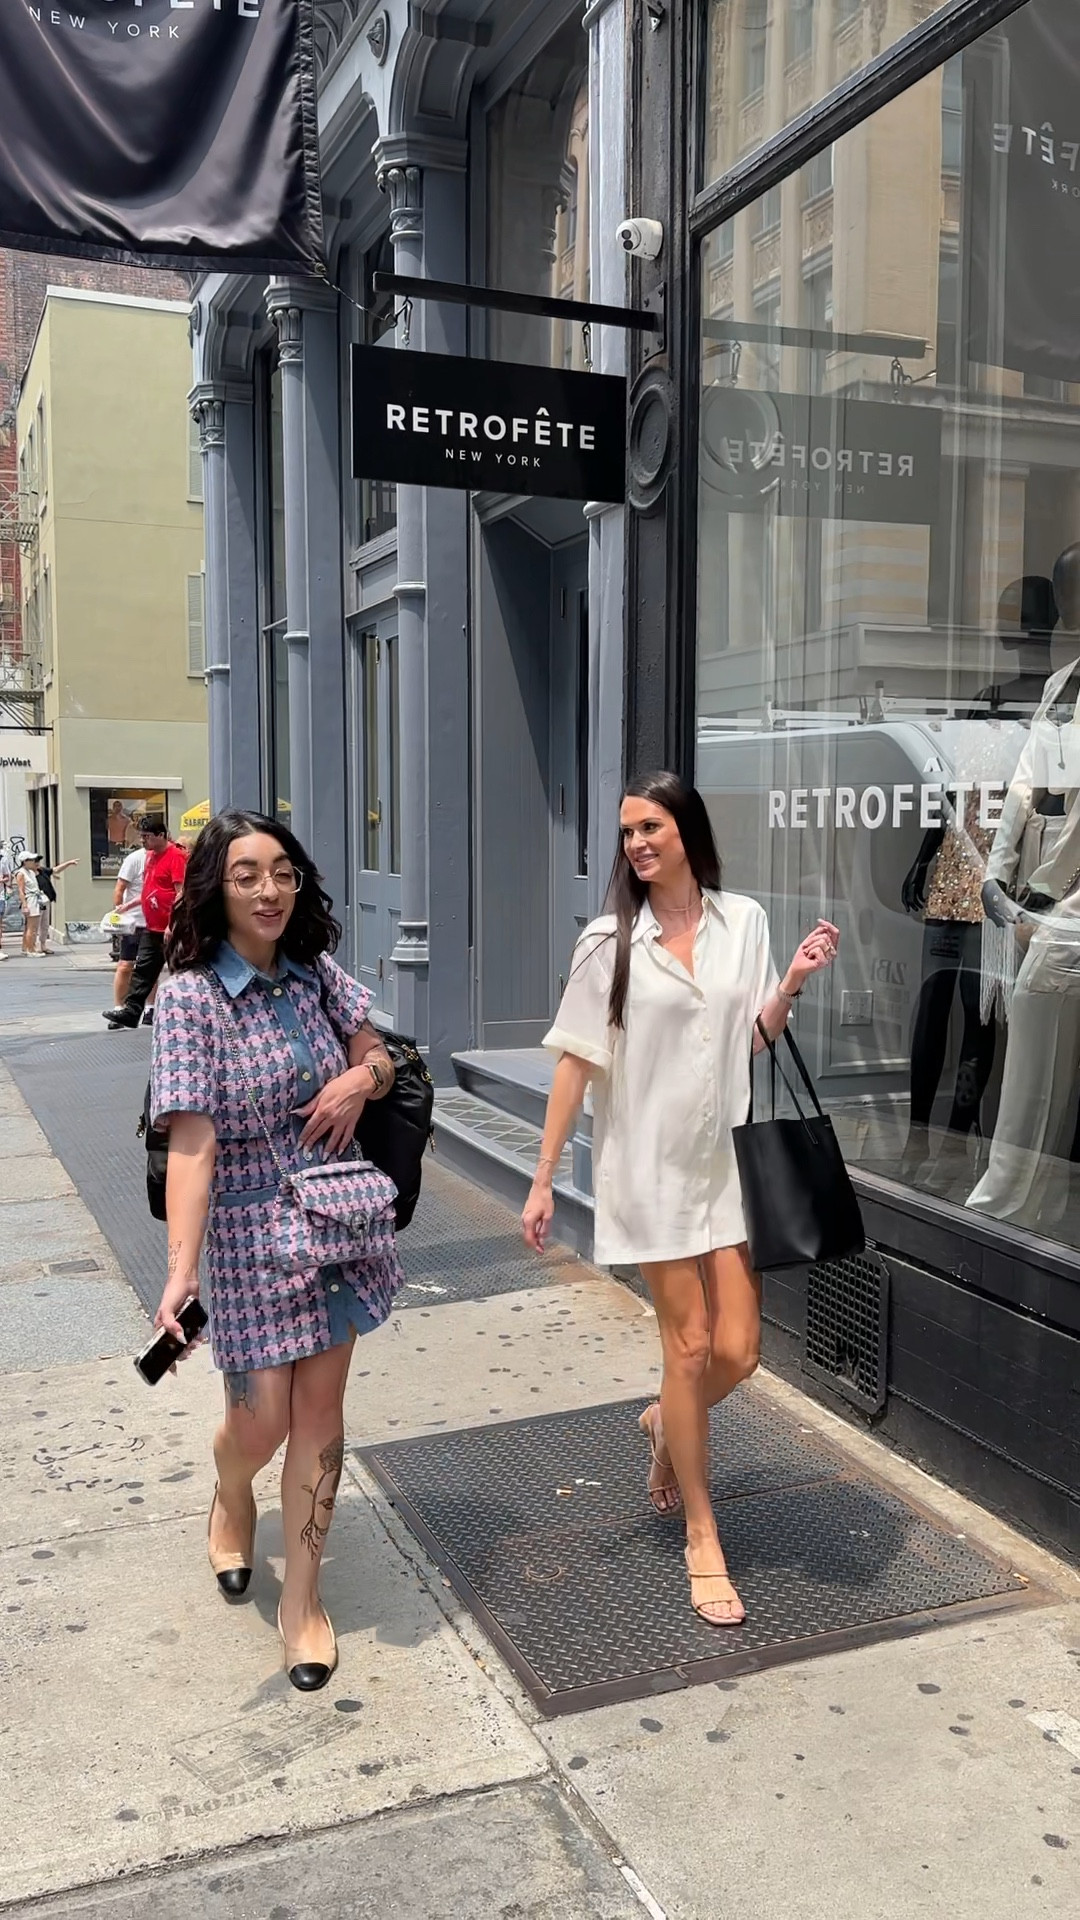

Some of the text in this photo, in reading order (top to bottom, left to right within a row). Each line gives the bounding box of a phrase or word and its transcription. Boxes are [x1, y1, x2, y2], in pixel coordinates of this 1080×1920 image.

[29, 6, 86, 29] NEW
[107, 20, 180, 39] YORK
[386, 403, 595, 450] RETROFÊTE
[445, 448, 541, 468] NEW YORK
[768, 757, 1005, 829] RETROFÊTE
